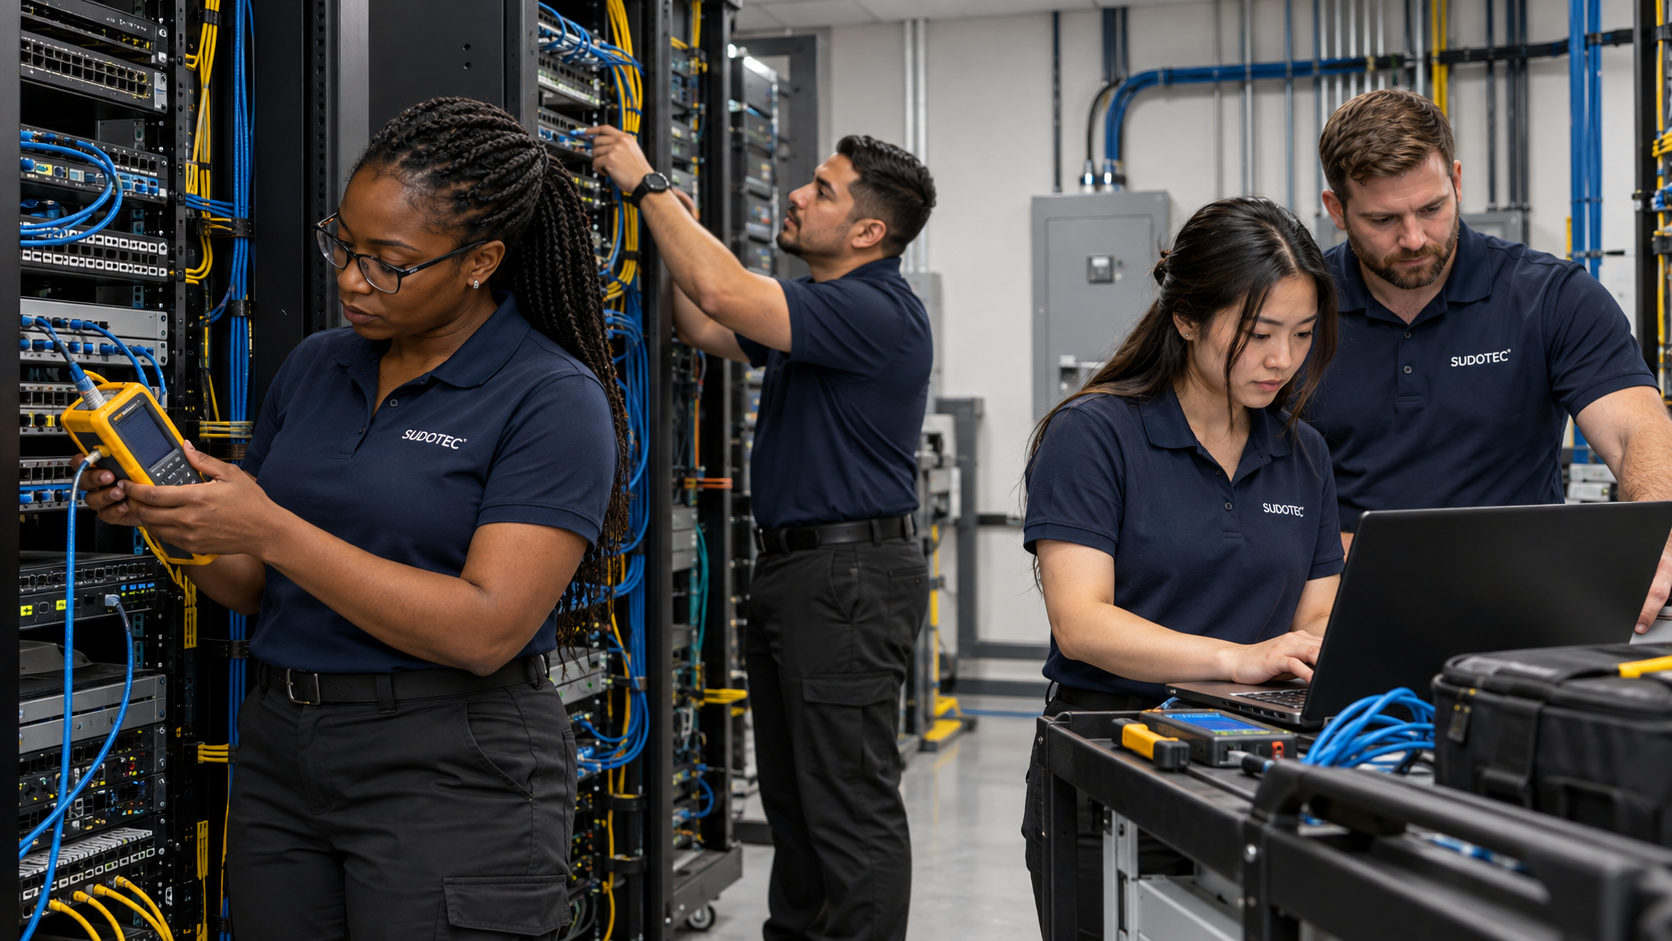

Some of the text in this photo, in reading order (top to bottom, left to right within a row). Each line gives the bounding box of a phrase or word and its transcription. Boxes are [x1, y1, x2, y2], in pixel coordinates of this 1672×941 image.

[1450, 350, 1509, 367] SUDOTEC
[401, 429, 464, 450] SUDOTEC
[1262, 502, 1304, 518] SUDOTEC
